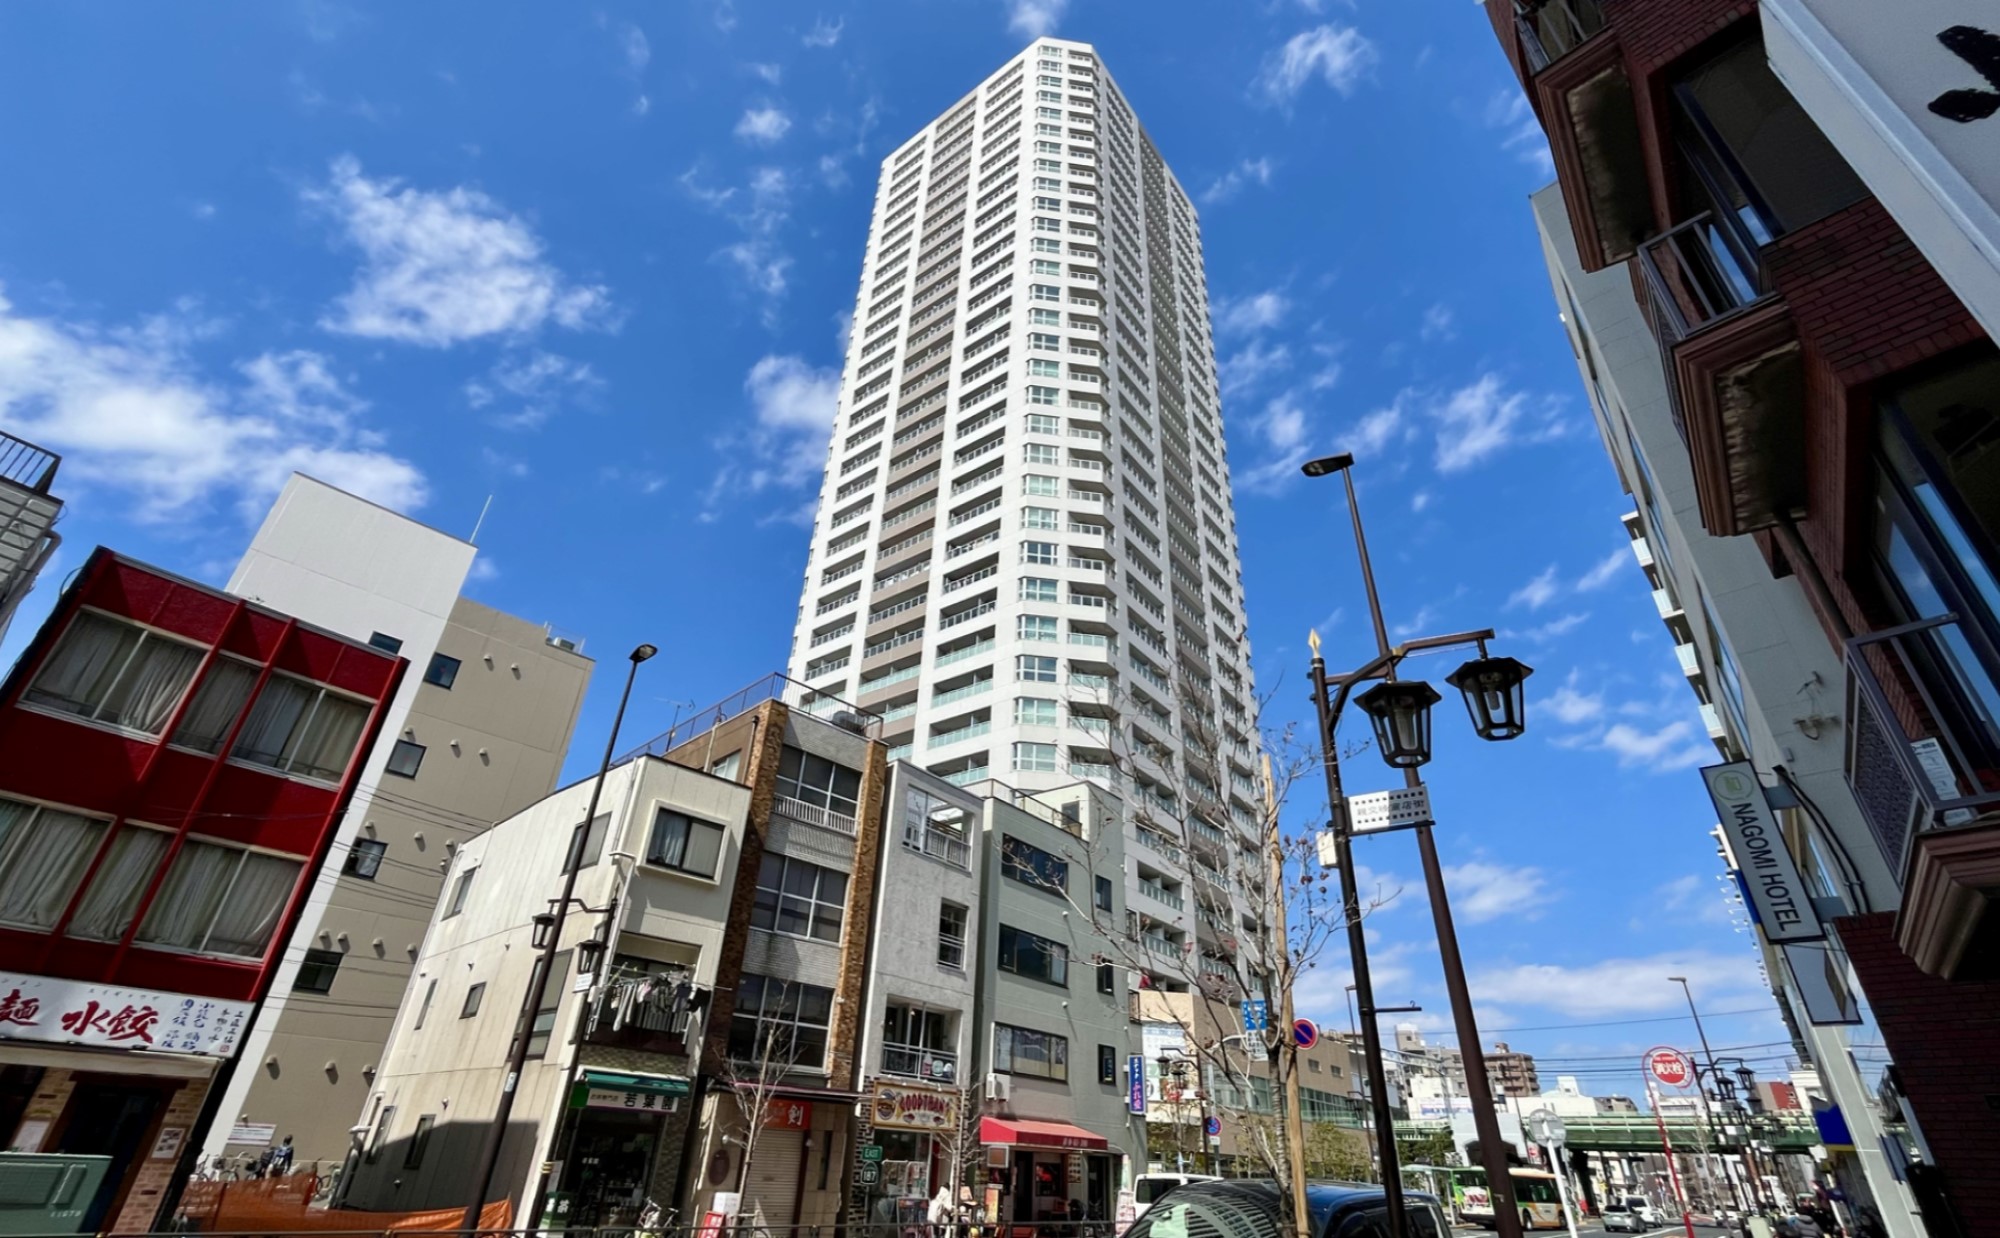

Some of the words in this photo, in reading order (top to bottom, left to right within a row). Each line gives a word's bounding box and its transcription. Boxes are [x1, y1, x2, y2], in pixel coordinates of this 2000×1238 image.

[1731, 803, 1778, 870] NAGOMI
[1759, 873, 1802, 932] HOTEL
[62, 1000, 158, 1044] 水餃
[1653, 1061, 1685, 1075] 消火栓
[624, 1091, 674, 1111] 若葉園
[863, 1171, 876, 1182] 187
